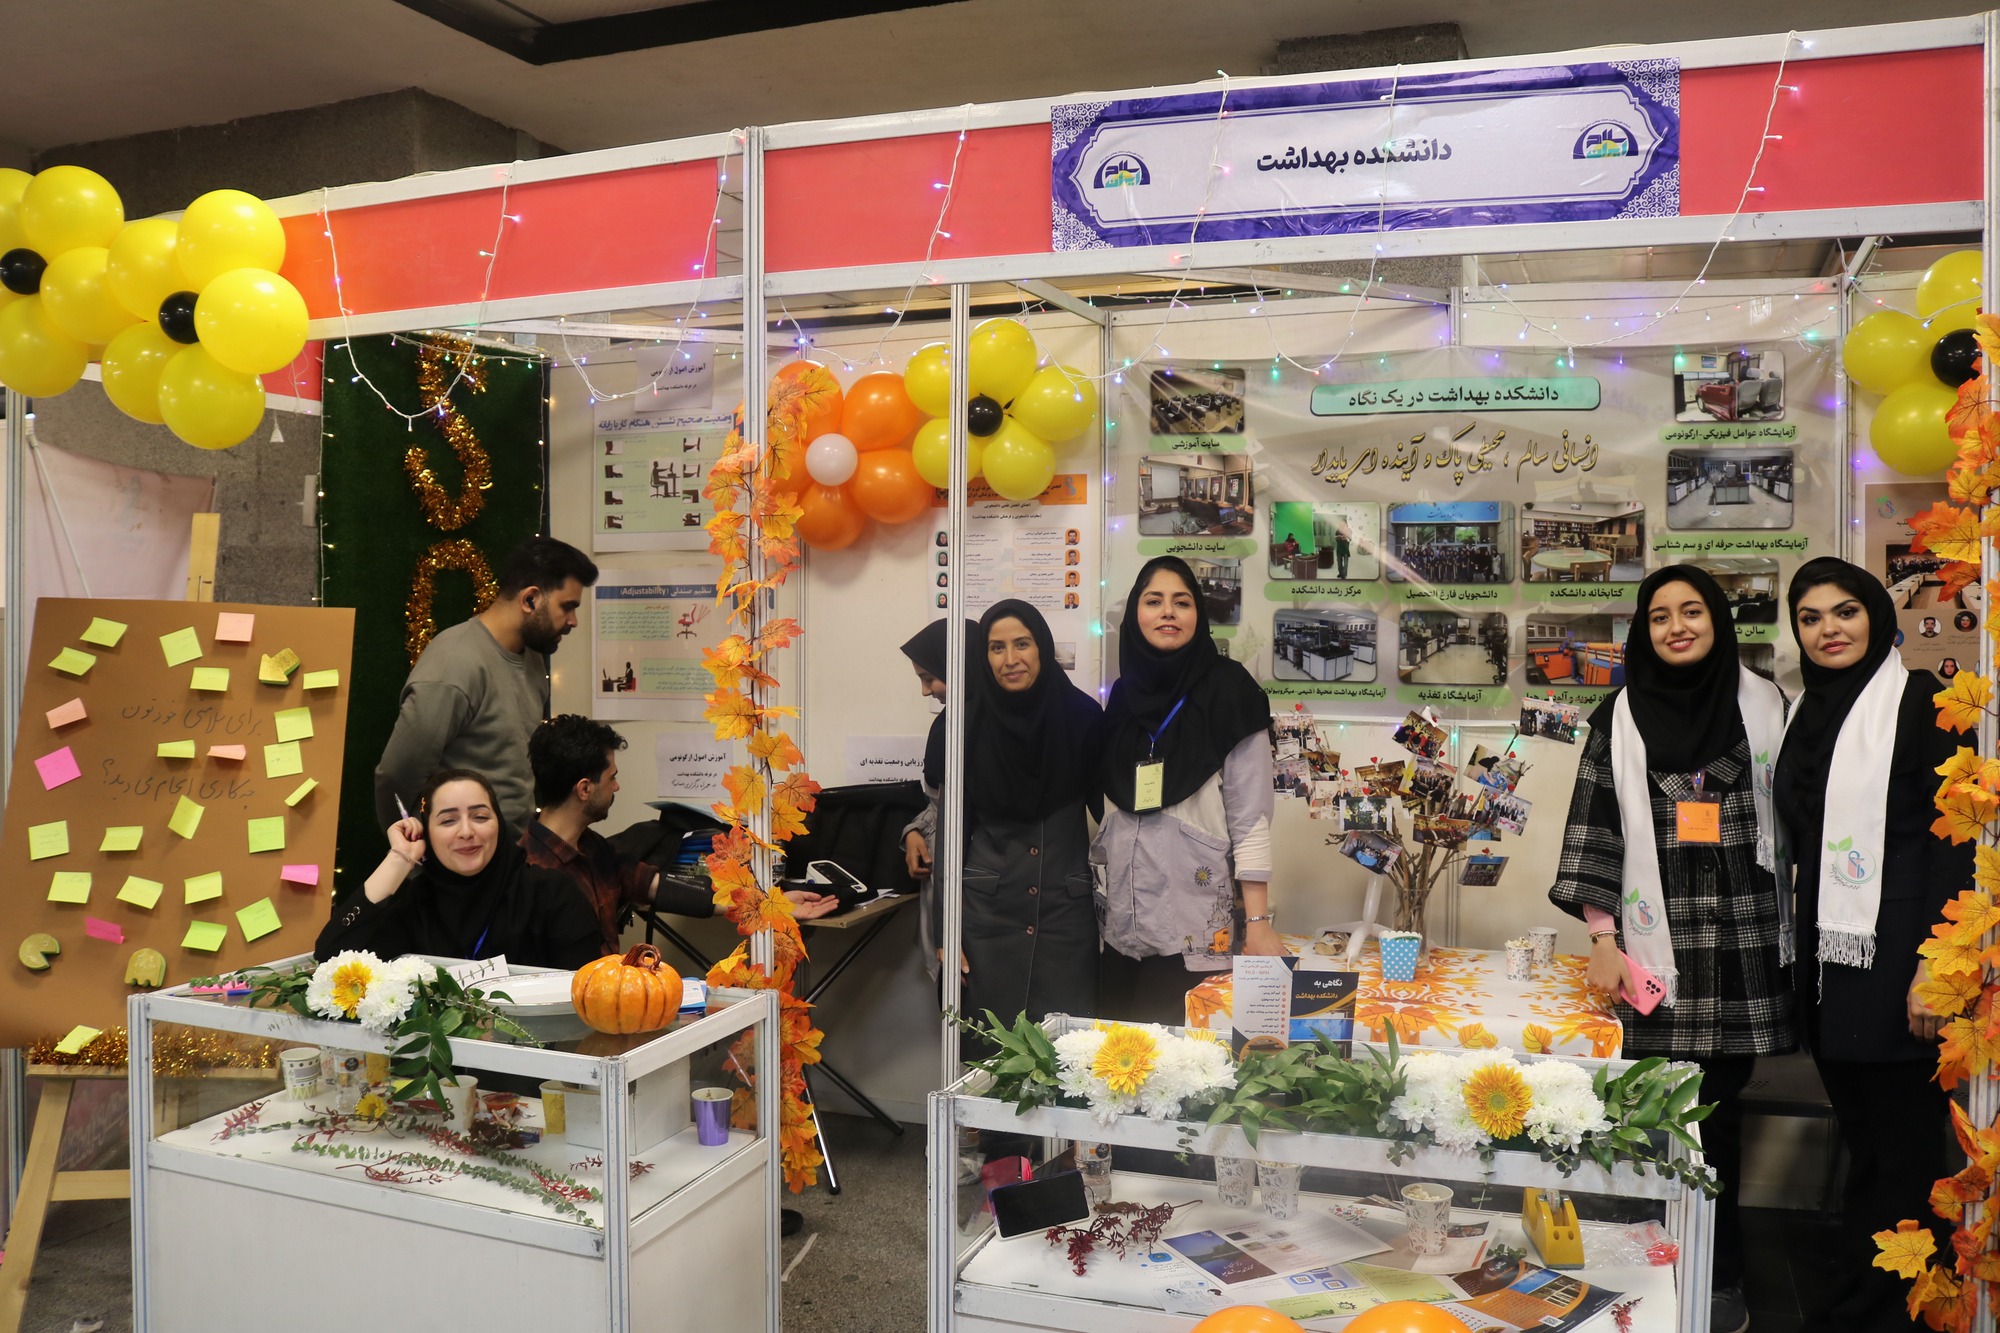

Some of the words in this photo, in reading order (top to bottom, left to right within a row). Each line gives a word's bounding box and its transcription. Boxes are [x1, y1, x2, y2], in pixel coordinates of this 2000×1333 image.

[1353, 138, 1452, 165] دانشکده
[1256, 145, 1350, 175] بهداشت
[1348, 389, 1377, 407] نگاه
[1380, 388, 1404, 407] یک
[1406, 389, 1424, 407] در
[1428, 386, 1490, 406] بهداشت
[1494, 385, 1559, 401] دانشکده
[629, 418, 651, 430] هنگام
[1732, 429, 1757, 440] عوامل
[1759, 425, 1796, 438] آزمایشگاه
[1171, 437, 1200, 450] آموزشی
[1200, 438, 1220, 450] سایت
[1381, 431, 1427, 482] آینده
[1435, 421, 1477, 486] پاک
[1466, 429, 1506, 473] محیطی
[1552, 429, 1599, 472] انسانی
[1422, 452, 1433, 469] و
[1516, 439, 1549, 484] سالم
[1166, 542, 1203, 554] دانشجویی
[1205, 542, 1226, 553] سایت
[1652, 539, 1681, 551] شناسی
[1682, 543, 1696, 552] سم
[1697, 543, 1703, 551] و
[1704, 539, 1714, 550] ای
[1715, 538, 1734, 551] حرفه
[1736, 538, 1768, 550] بهداشت
[1770, 537, 1809, 550] آزمایشگاه
[620, 586, 669, 596] (Adjustability)
[670, 587, 693, 597] صندلی
[693, 587, 712, 596] تنظیم
[1291, 585, 1326, 595] دانشکده
[1326, 586, 1343, 597] رشد
[1344, 586, 1362, 597] مرکز
[1405, 588, 1438, 600] التحصیل
[1439, 588, 1457, 601] فارغ
[1458, 589, 1498, 600] دانشجویان
[1550, 588, 1587, 597] دانشکده
[1588, 588, 1624, 599] کتابخانه
[1745, 625, 1766, 637] سالن
[1316, 687, 1333, 696] محیط
[1333, 687, 1358, 697] بهداشت
[1358, 687, 1387, 698] آزمایشگاه
[1418, 689, 1441, 700] تغذیه
[1442, 689, 1483, 702] آزمایشگاه
[1569, 696, 1574, 704] و
[121, 698, 177, 725] خودتون
[225, 708, 262, 736] برای
[669, 753, 693, 762] ارگونومی
[859, 757, 868, 767] ای
[884, 758, 904, 767] وضعیت
[904, 757, 924, 767] رزیابی
[134, 776, 154, 796] می
[153, 775, 195, 805] انجام
[199, 778, 251, 800] کاری
[1313, 980, 1322, 988] به
[1322, 978, 1343, 989] نگاهی
[1295, 992, 1316, 1000] بهداشت
